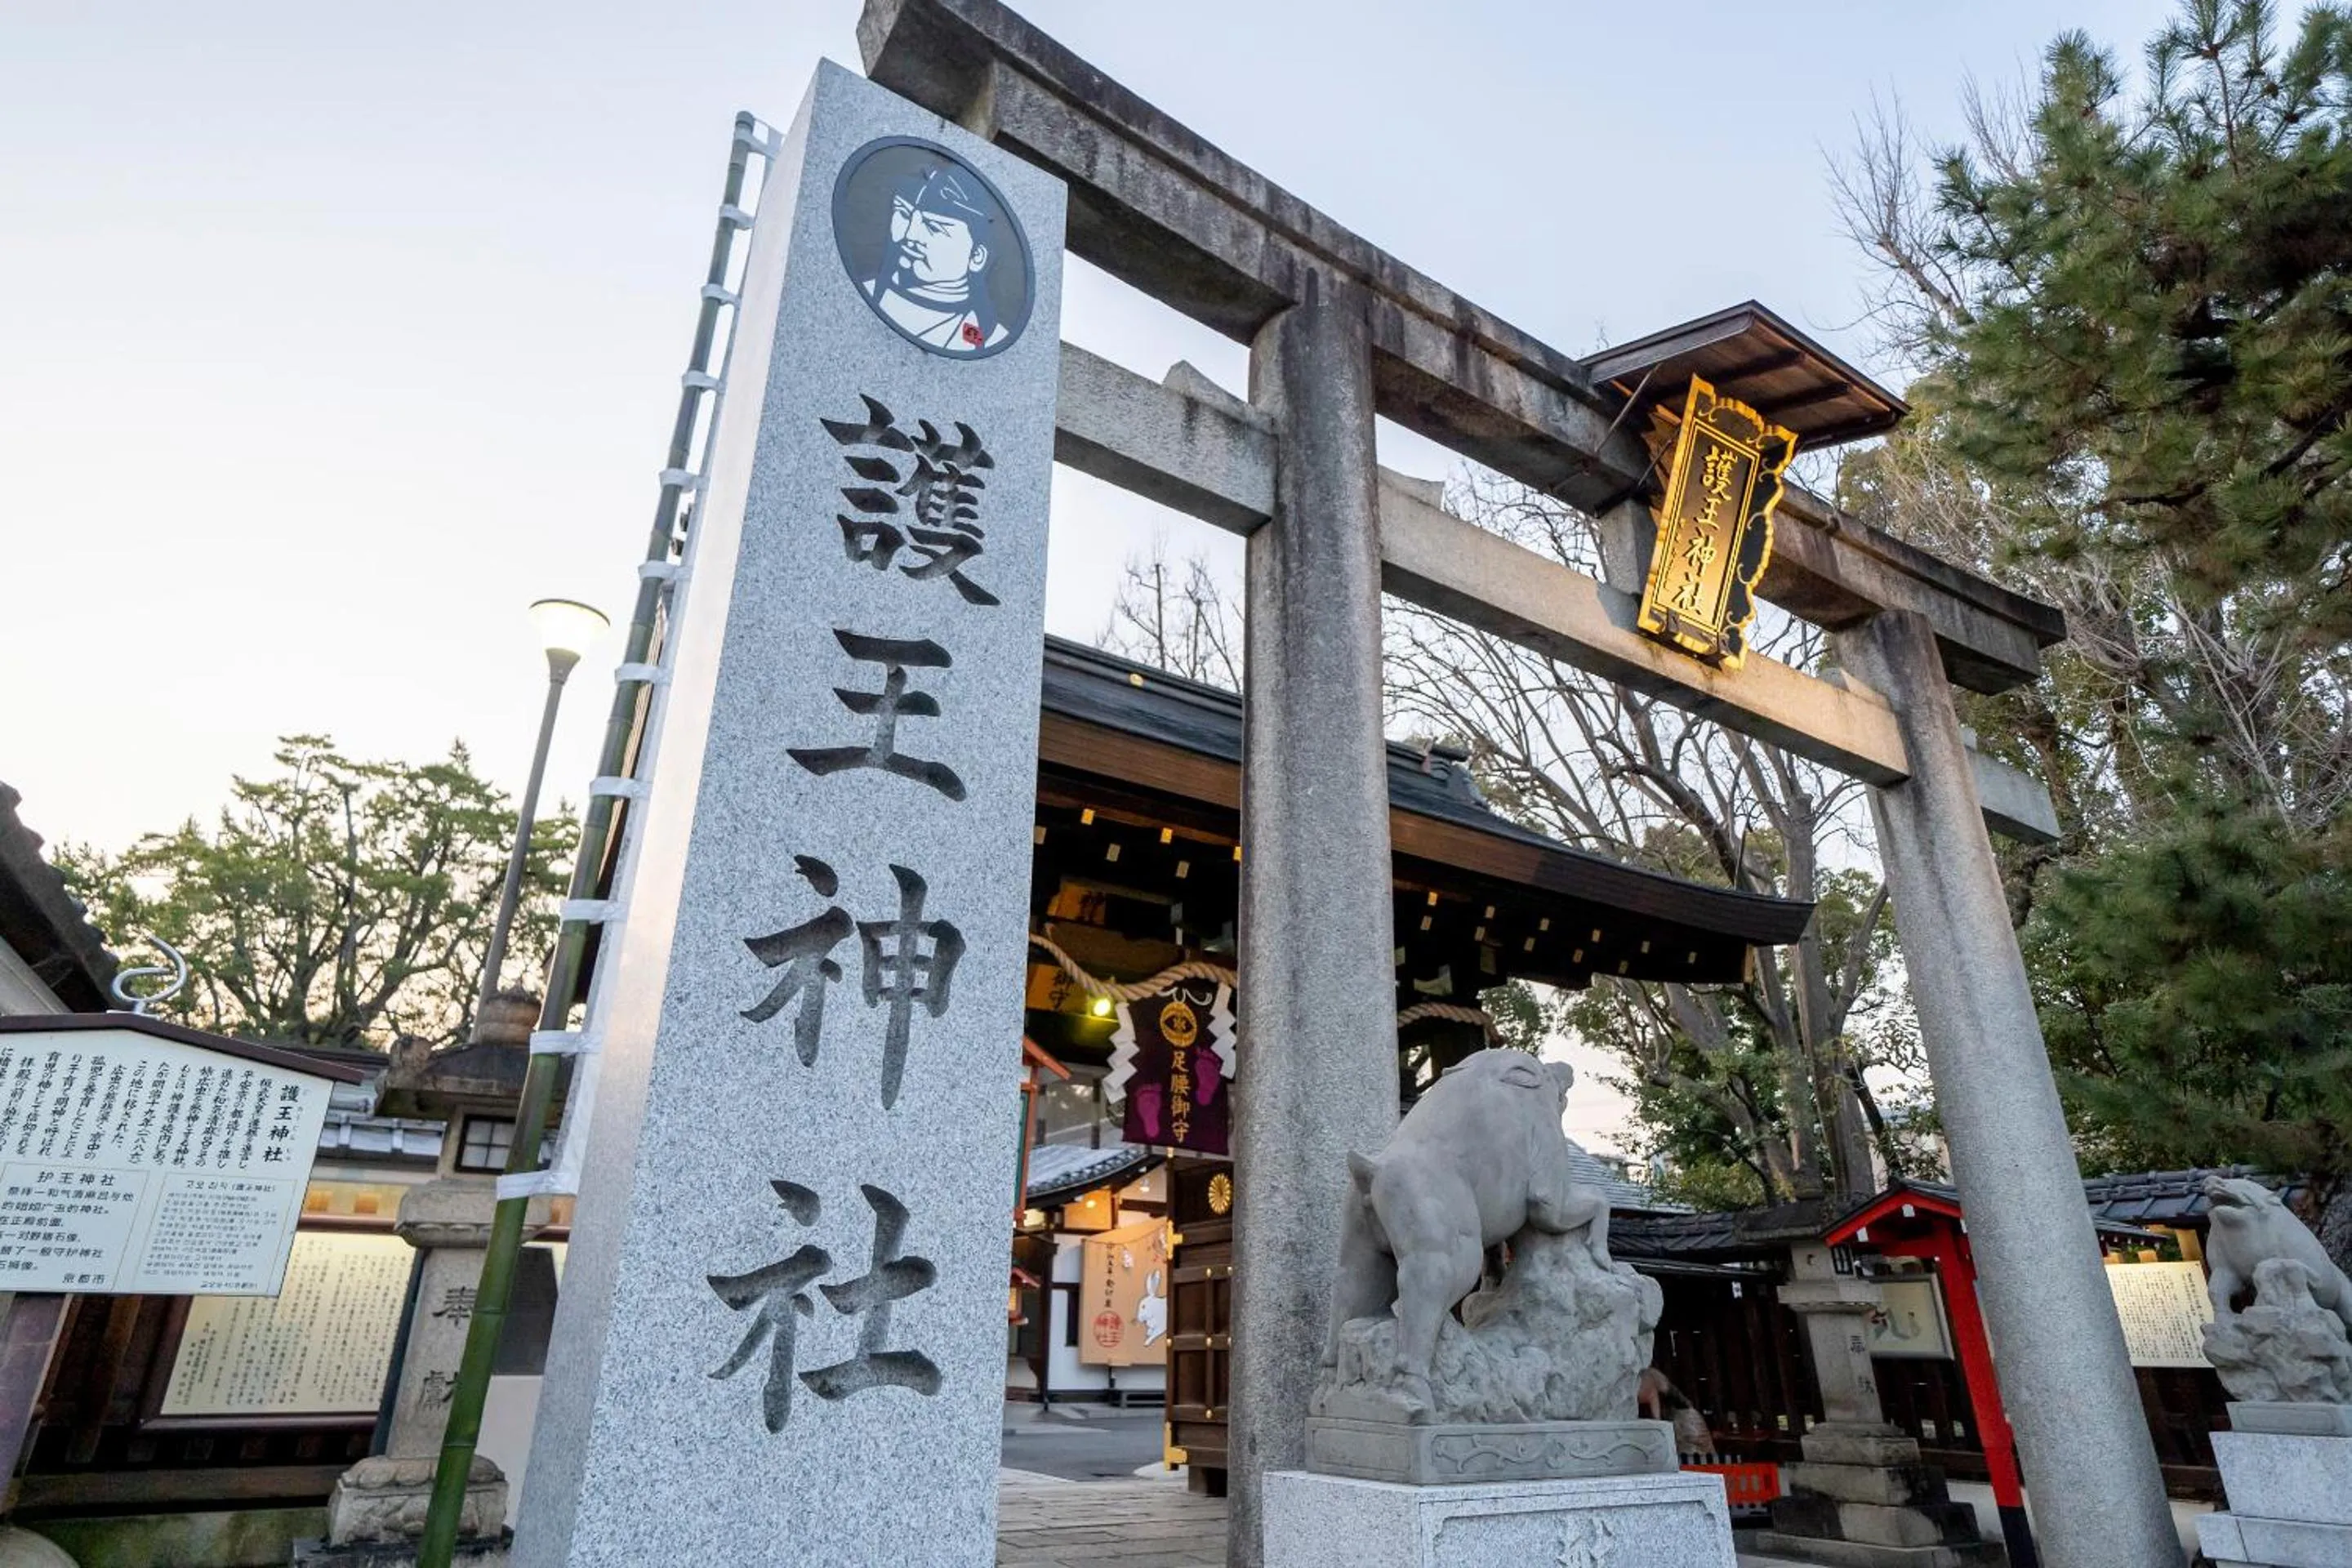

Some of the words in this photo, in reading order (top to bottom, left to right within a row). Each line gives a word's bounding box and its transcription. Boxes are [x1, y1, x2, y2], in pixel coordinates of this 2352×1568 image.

[706, 393, 1000, 1435] 護王神社
[262, 1084, 300, 1162] 護王神社
[37, 1171, 115, 1185] 护王神社
